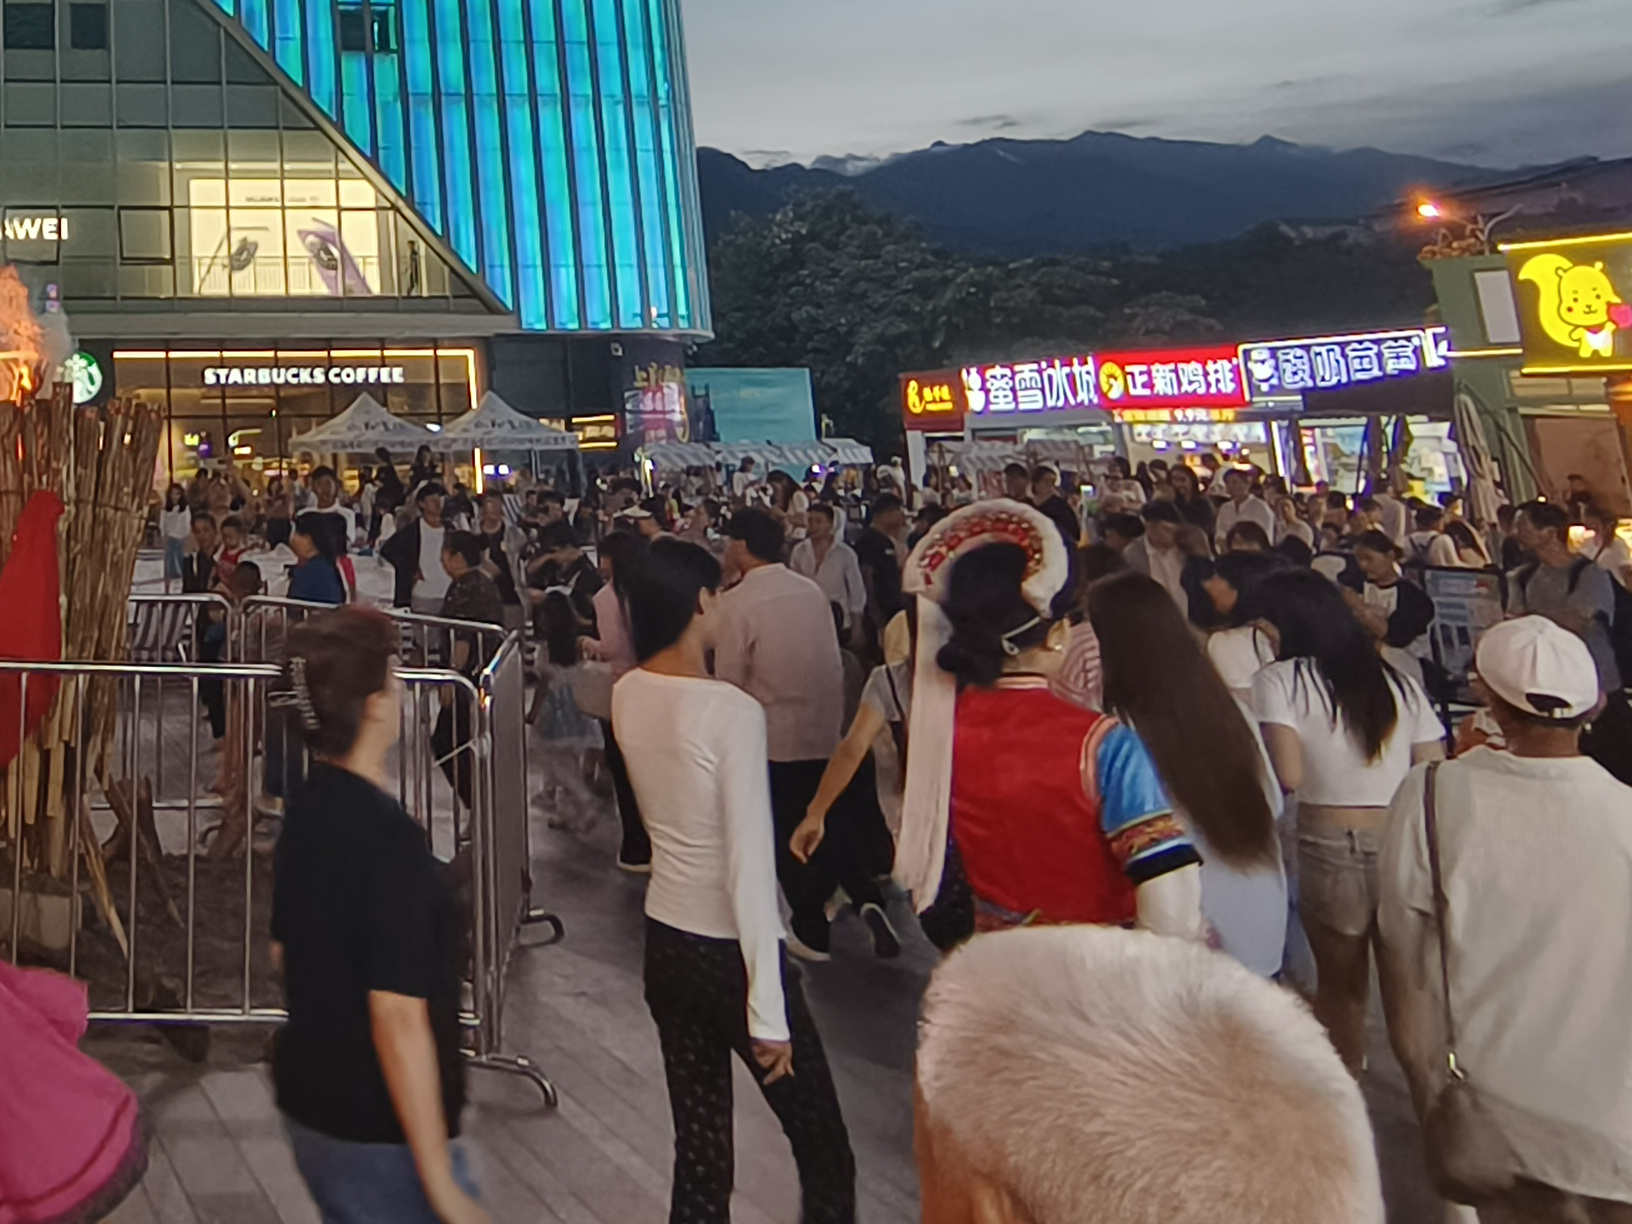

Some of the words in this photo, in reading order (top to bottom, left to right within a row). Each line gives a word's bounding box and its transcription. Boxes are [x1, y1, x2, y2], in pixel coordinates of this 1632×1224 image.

[203, 367, 326, 386] STARBUCKS
[328, 366, 405, 384] COFFEE
[985, 356, 1099, 412] 蜜雪冰城
[1124, 358, 1236, 397] 正新鸡排
